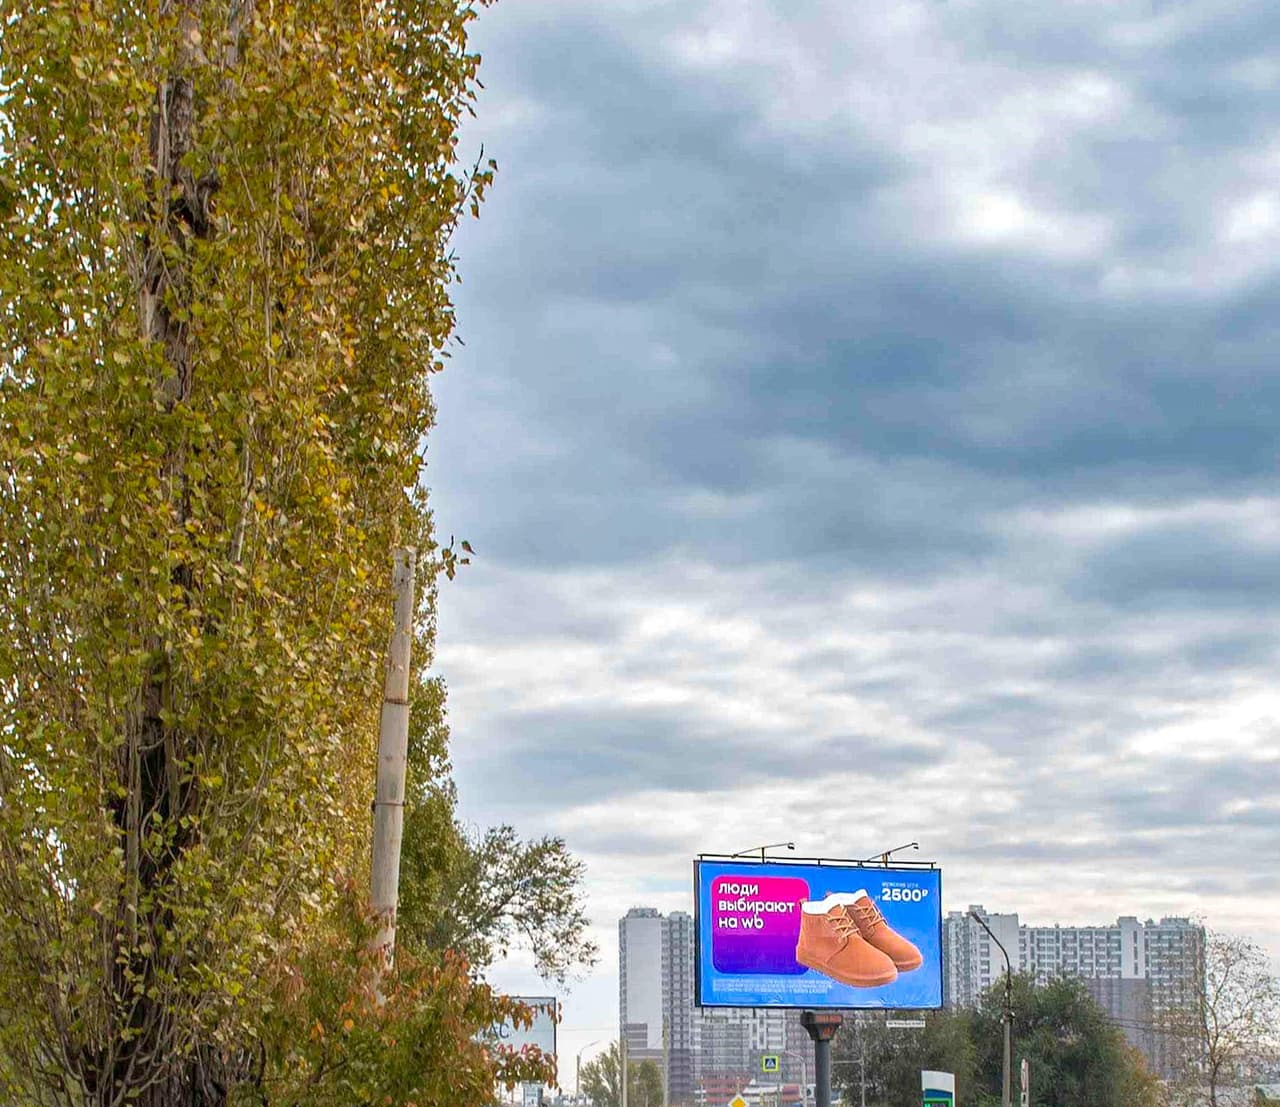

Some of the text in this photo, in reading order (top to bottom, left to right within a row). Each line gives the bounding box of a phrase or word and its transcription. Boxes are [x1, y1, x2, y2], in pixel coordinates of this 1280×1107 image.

[718, 883, 759, 897] люди
[718, 897, 795, 915] выбирают
[718, 914, 764, 929] на wb
